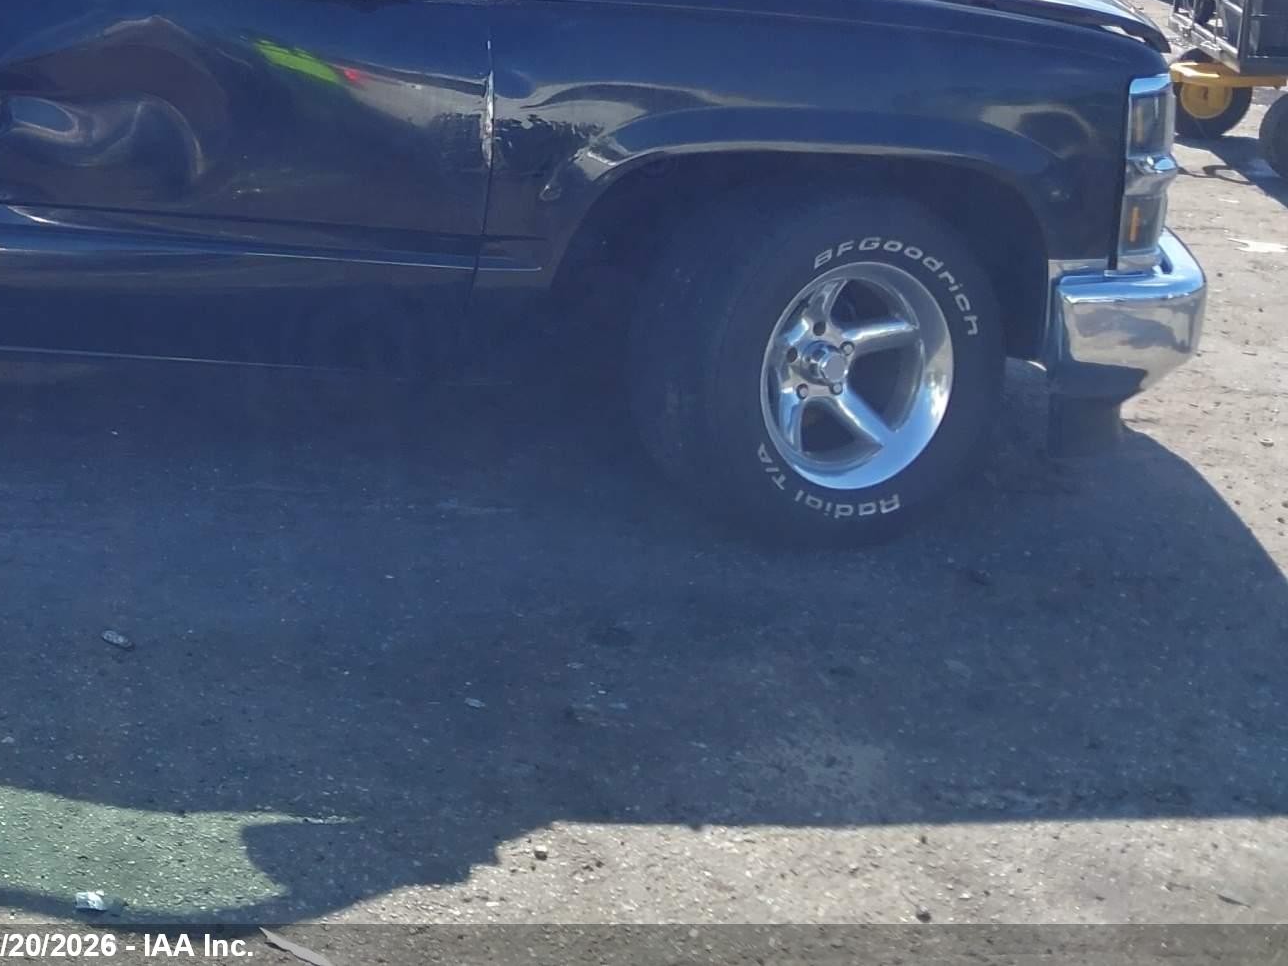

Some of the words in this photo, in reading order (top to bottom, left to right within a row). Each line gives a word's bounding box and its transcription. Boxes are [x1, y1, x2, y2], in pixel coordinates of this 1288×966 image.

[813, 236, 979, 336] BFGoodrich
[757, 442, 786, 490] T/A
[794, 489, 901, 519] Radial
